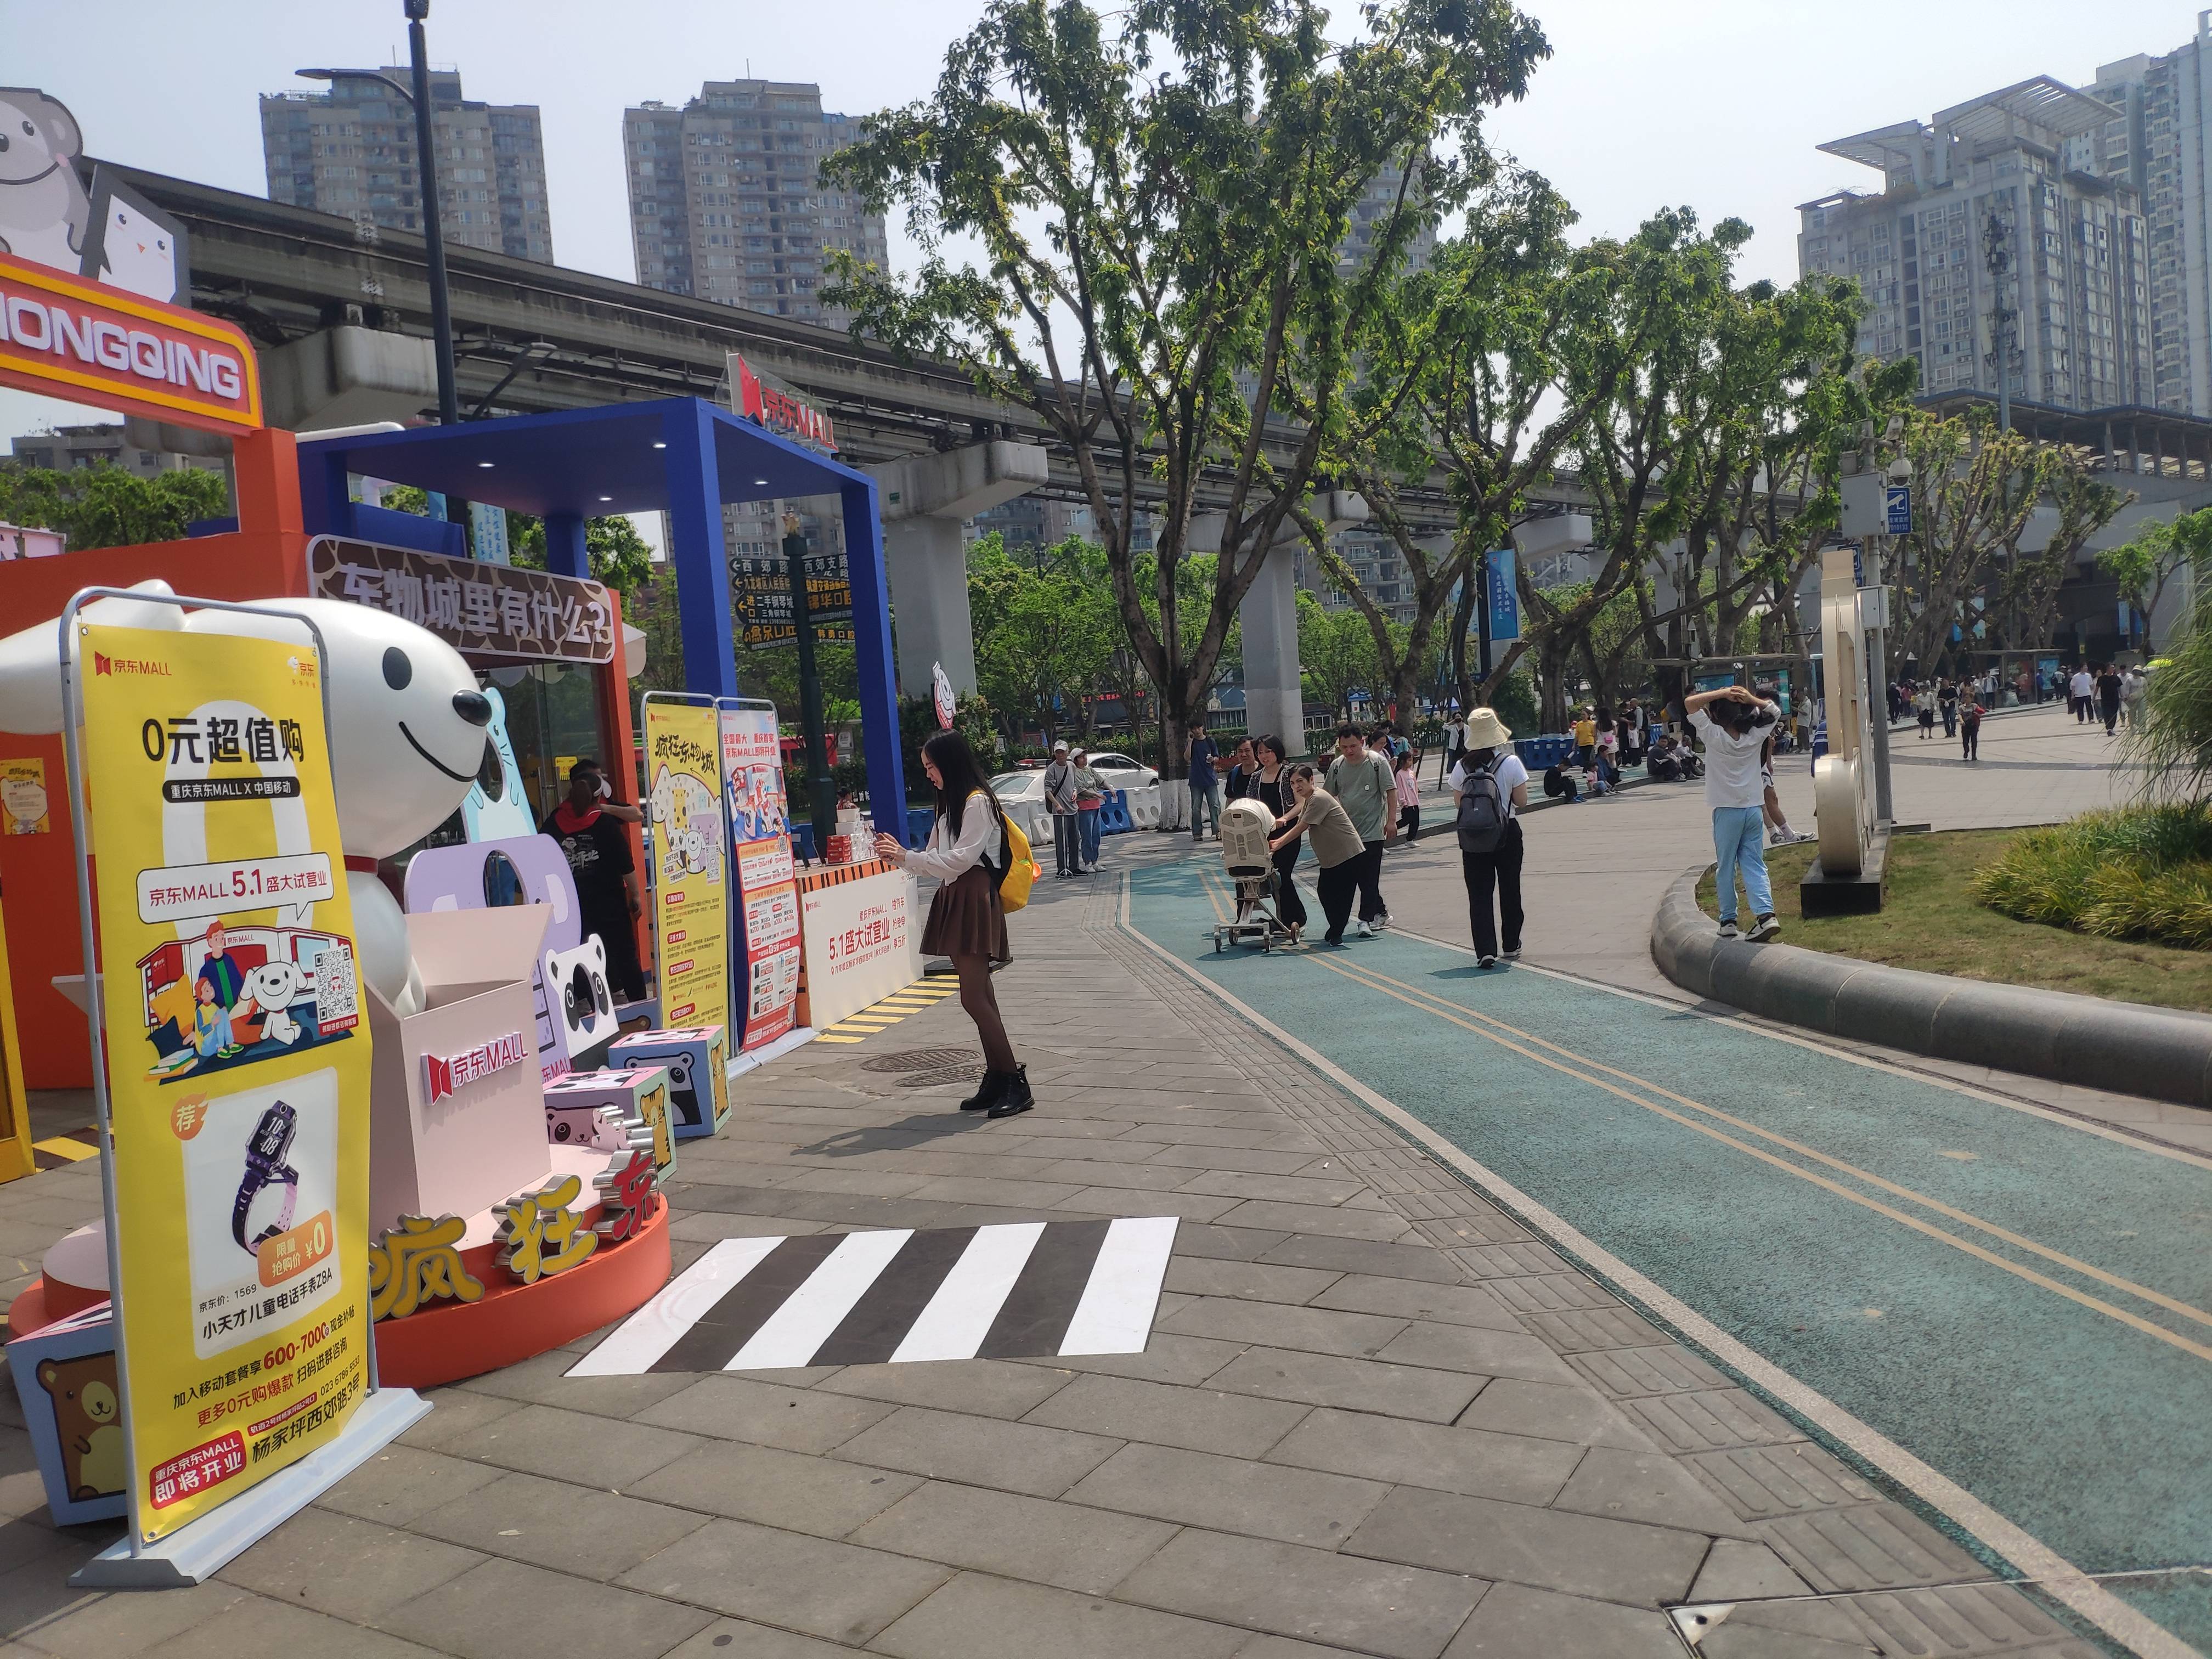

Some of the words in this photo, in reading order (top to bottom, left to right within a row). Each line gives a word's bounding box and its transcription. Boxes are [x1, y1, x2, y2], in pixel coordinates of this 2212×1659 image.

[0, 292, 240, 399] ONGQING
[764, 387, 839, 454] 京东MALL
[742, 559, 788, 574] 西郊路
[804, 555, 848, 573] 西郊支路
[114, 658, 172, 676] 京东MALL
[299, 662, 314, 677] 京东
[142, 716, 304, 765] 0元超值购
[655, 733, 716, 776] 疯狂东物城
[171, 781, 242, 799] 重庆京东MALL
[254, 780, 291, 795] 中国移动
[830, 917, 890, 960] 5.1盛大试营业
[453, 1033, 529, 1087] 京东MALL
[176, 1104, 195, 1132] 荐
[272, 1253, 301, 1277] 抢购价
[276, 1238, 296, 1256] 限量
[203, 1267, 333, 1340] 小天才儿童电话手表Z8A
[198, 1373, 294, 1429] 更多0元购爆款
[297, 1336, 347, 1385] 扫码进群咨询
[320, 1380, 334, 1396] 023
[335, 1367, 348, 1386] 6786
[252, 1372, 360, 1464] 杨家坪西郊路3号
[154, 1450, 242, 1503] 即将开业
[155, 1438, 239, 1483] 重庆京东MALL
